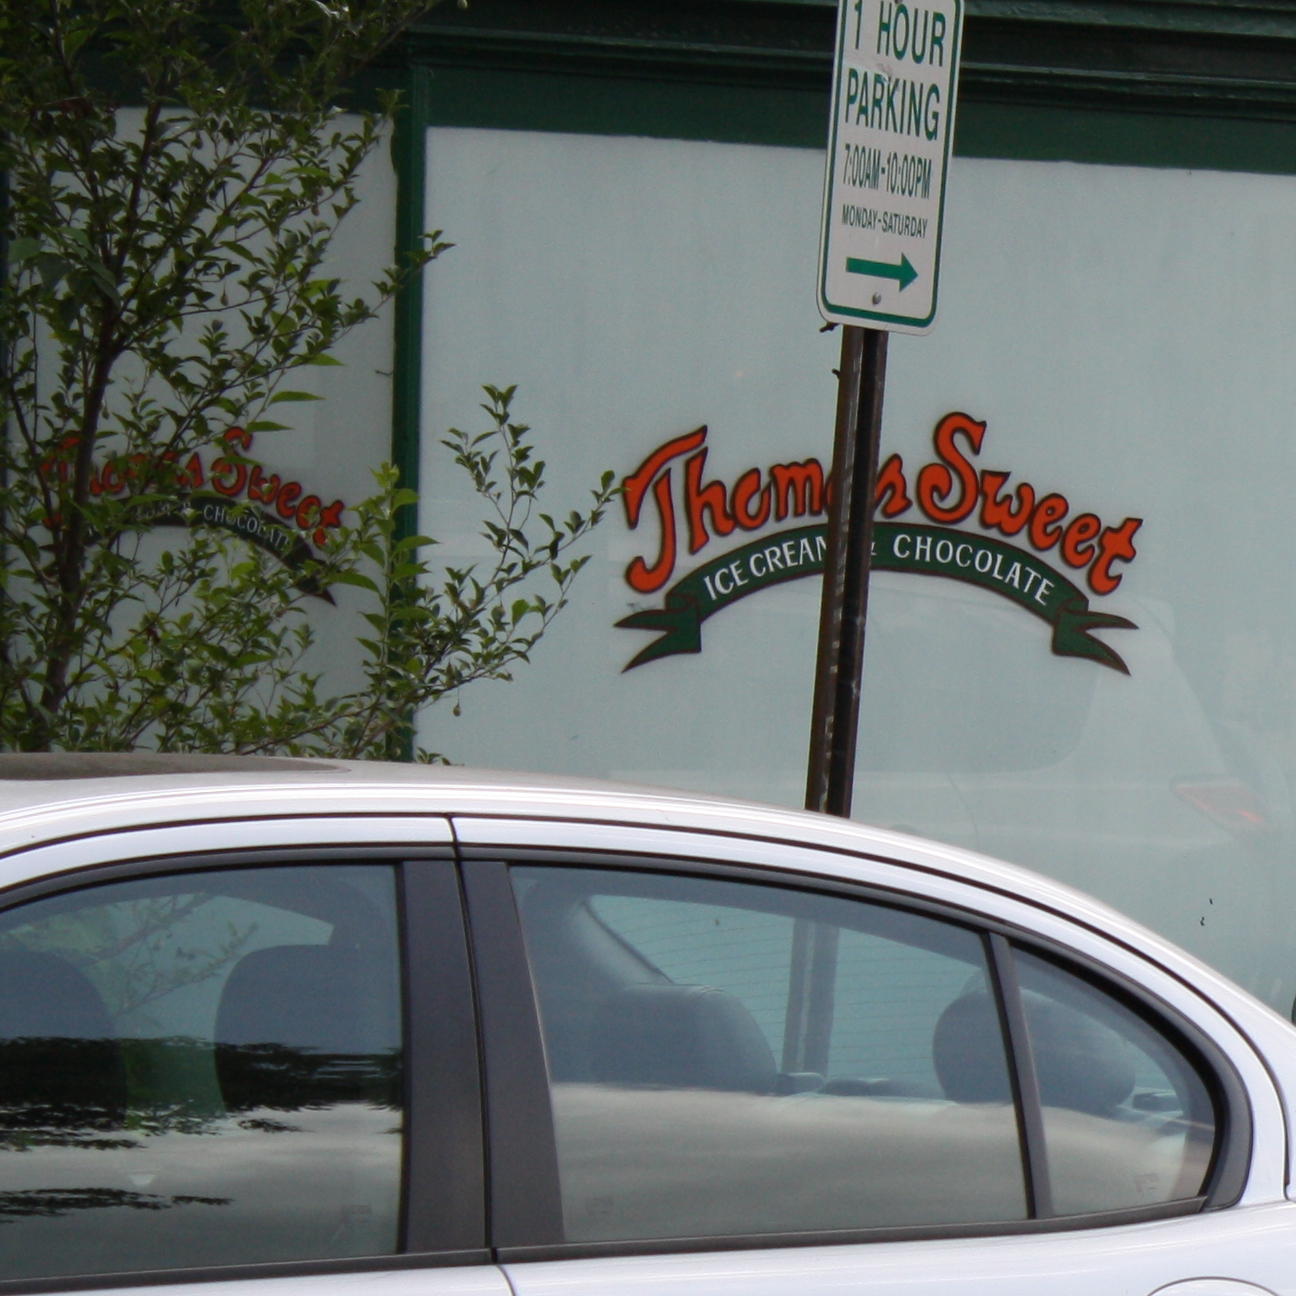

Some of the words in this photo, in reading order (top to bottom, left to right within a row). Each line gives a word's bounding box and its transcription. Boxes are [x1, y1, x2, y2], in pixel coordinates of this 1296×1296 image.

[851, 0, 863, 50] 1
[876, 1, 947, 67] HOUR
[844, 68, 941, 141] PARKING
[842, 204, 928, 238] MONDAY-SATURDAY
[622, 425, 914, 593] Thoms
[916, 411, 1144, 595] Sweet
[703, 560, 750, 601] ICE
[892, 534, 1055, 606] CHOCOLATE
